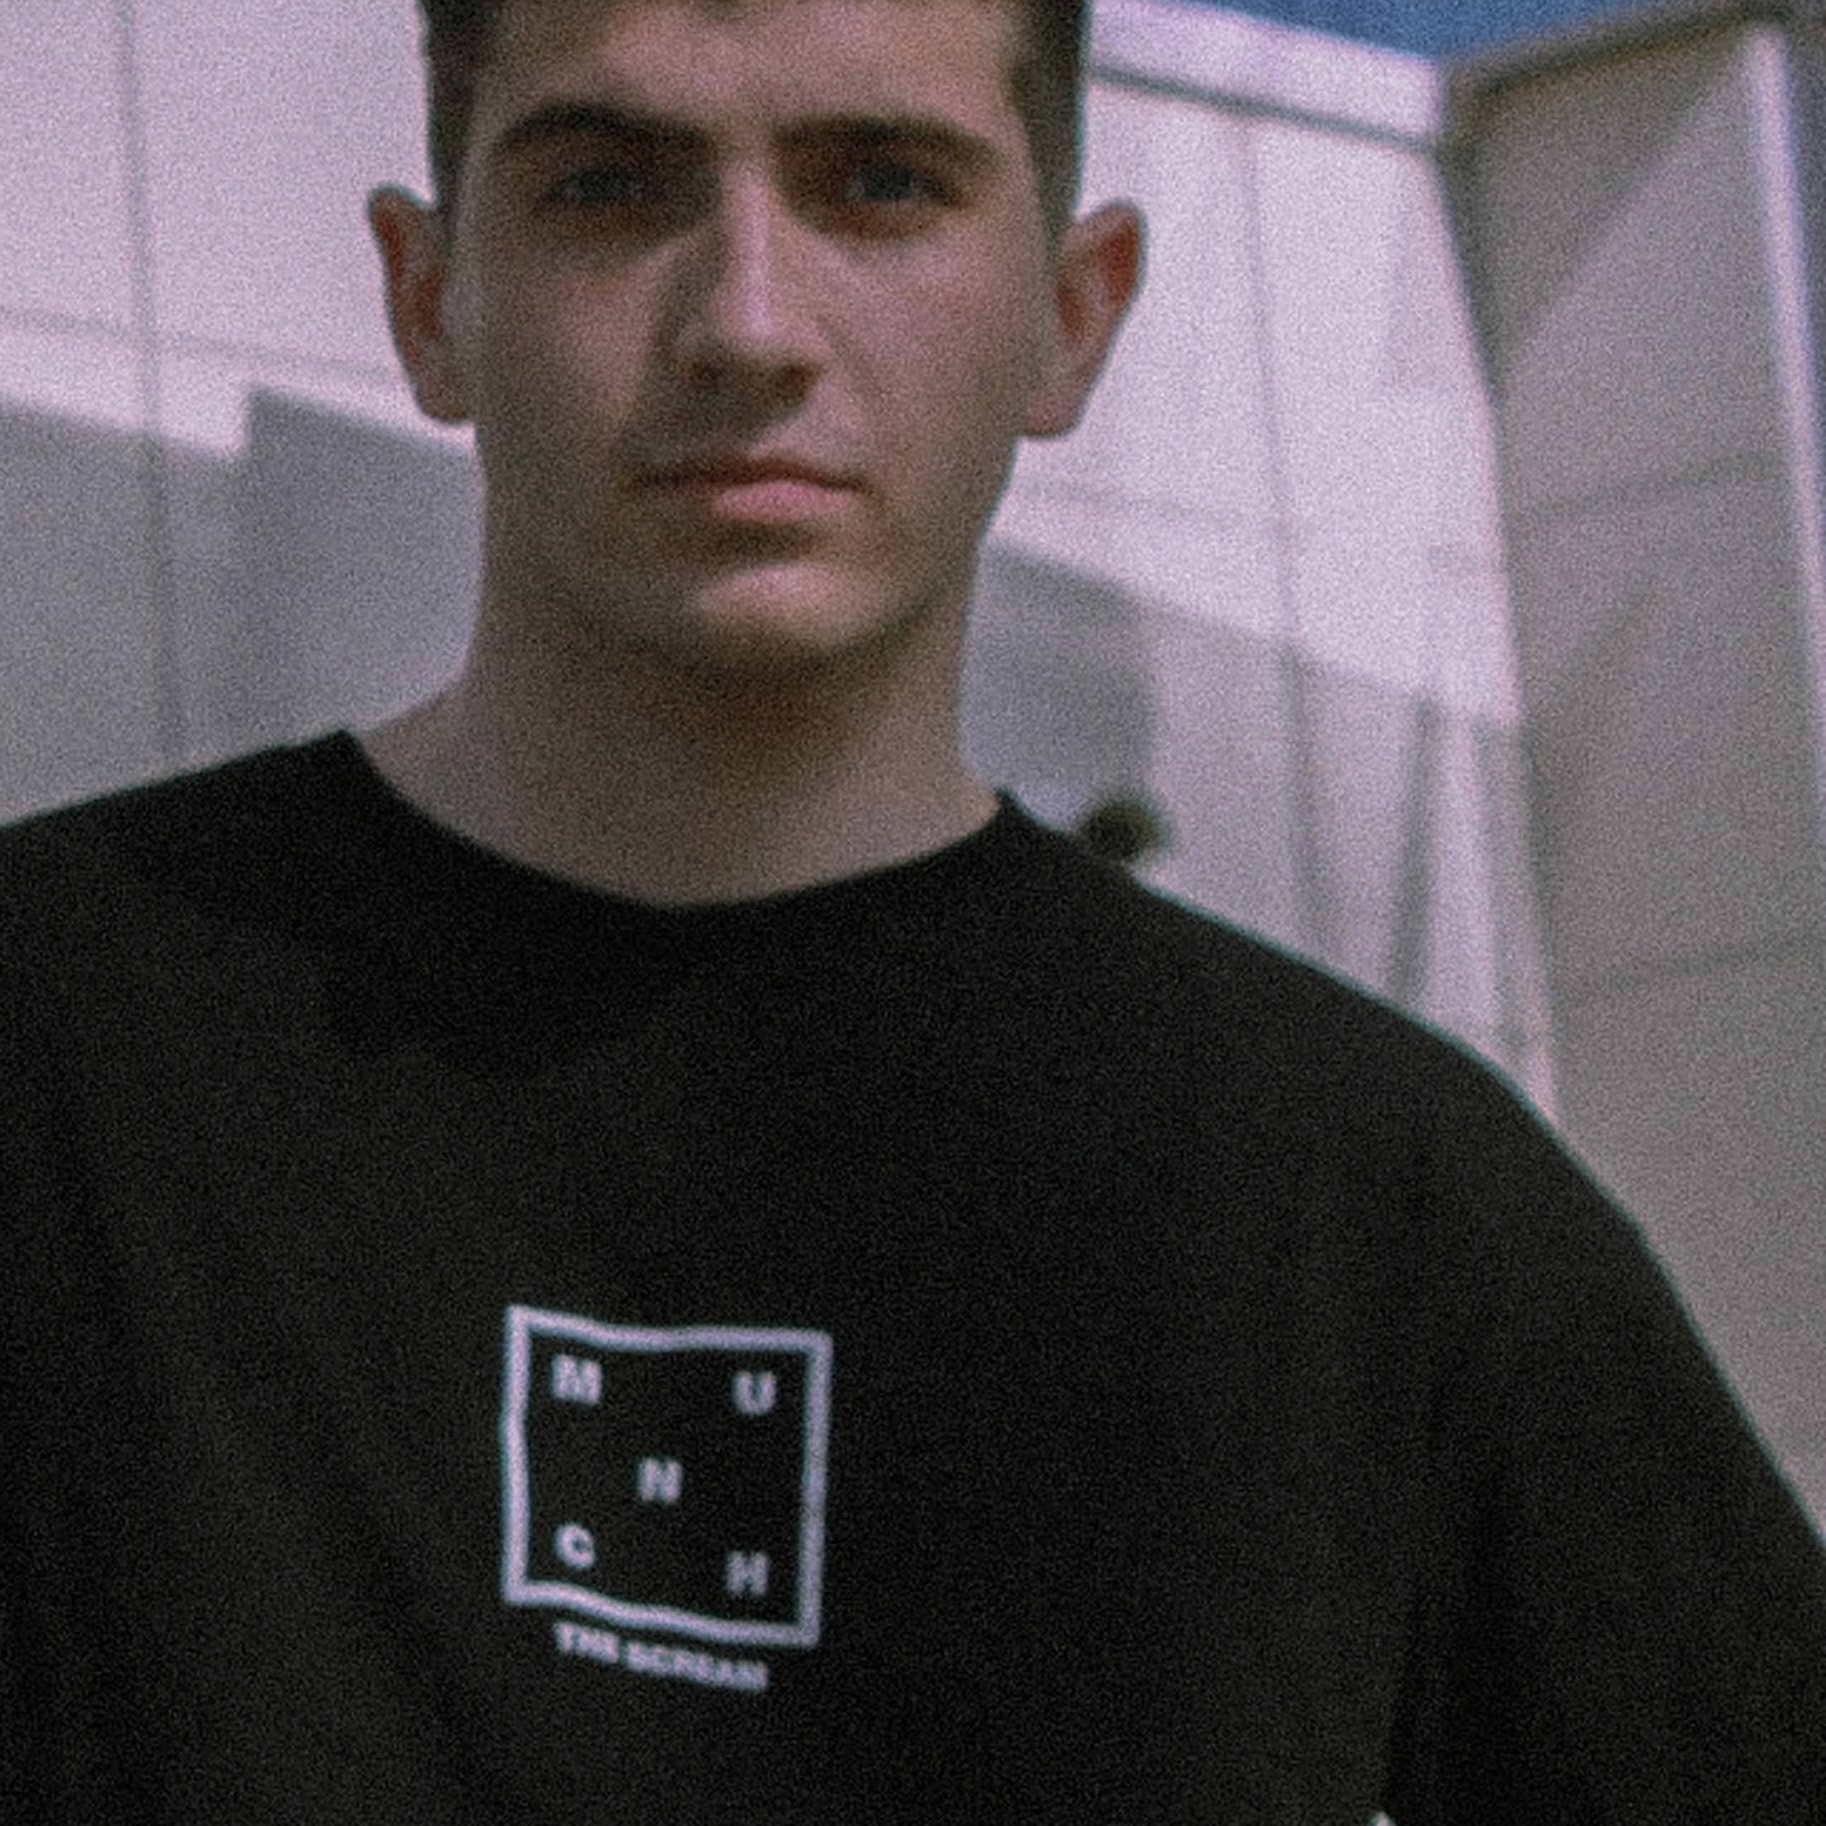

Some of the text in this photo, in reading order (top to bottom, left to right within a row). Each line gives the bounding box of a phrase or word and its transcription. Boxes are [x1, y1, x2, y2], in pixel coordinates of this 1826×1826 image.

[551, 1353, 776, 1414] M U
[638, 1458, 682, 1504] N
[555, 1523, 769, 1595] C H
[554, 1621, 769, 1691] THE SCREAM
